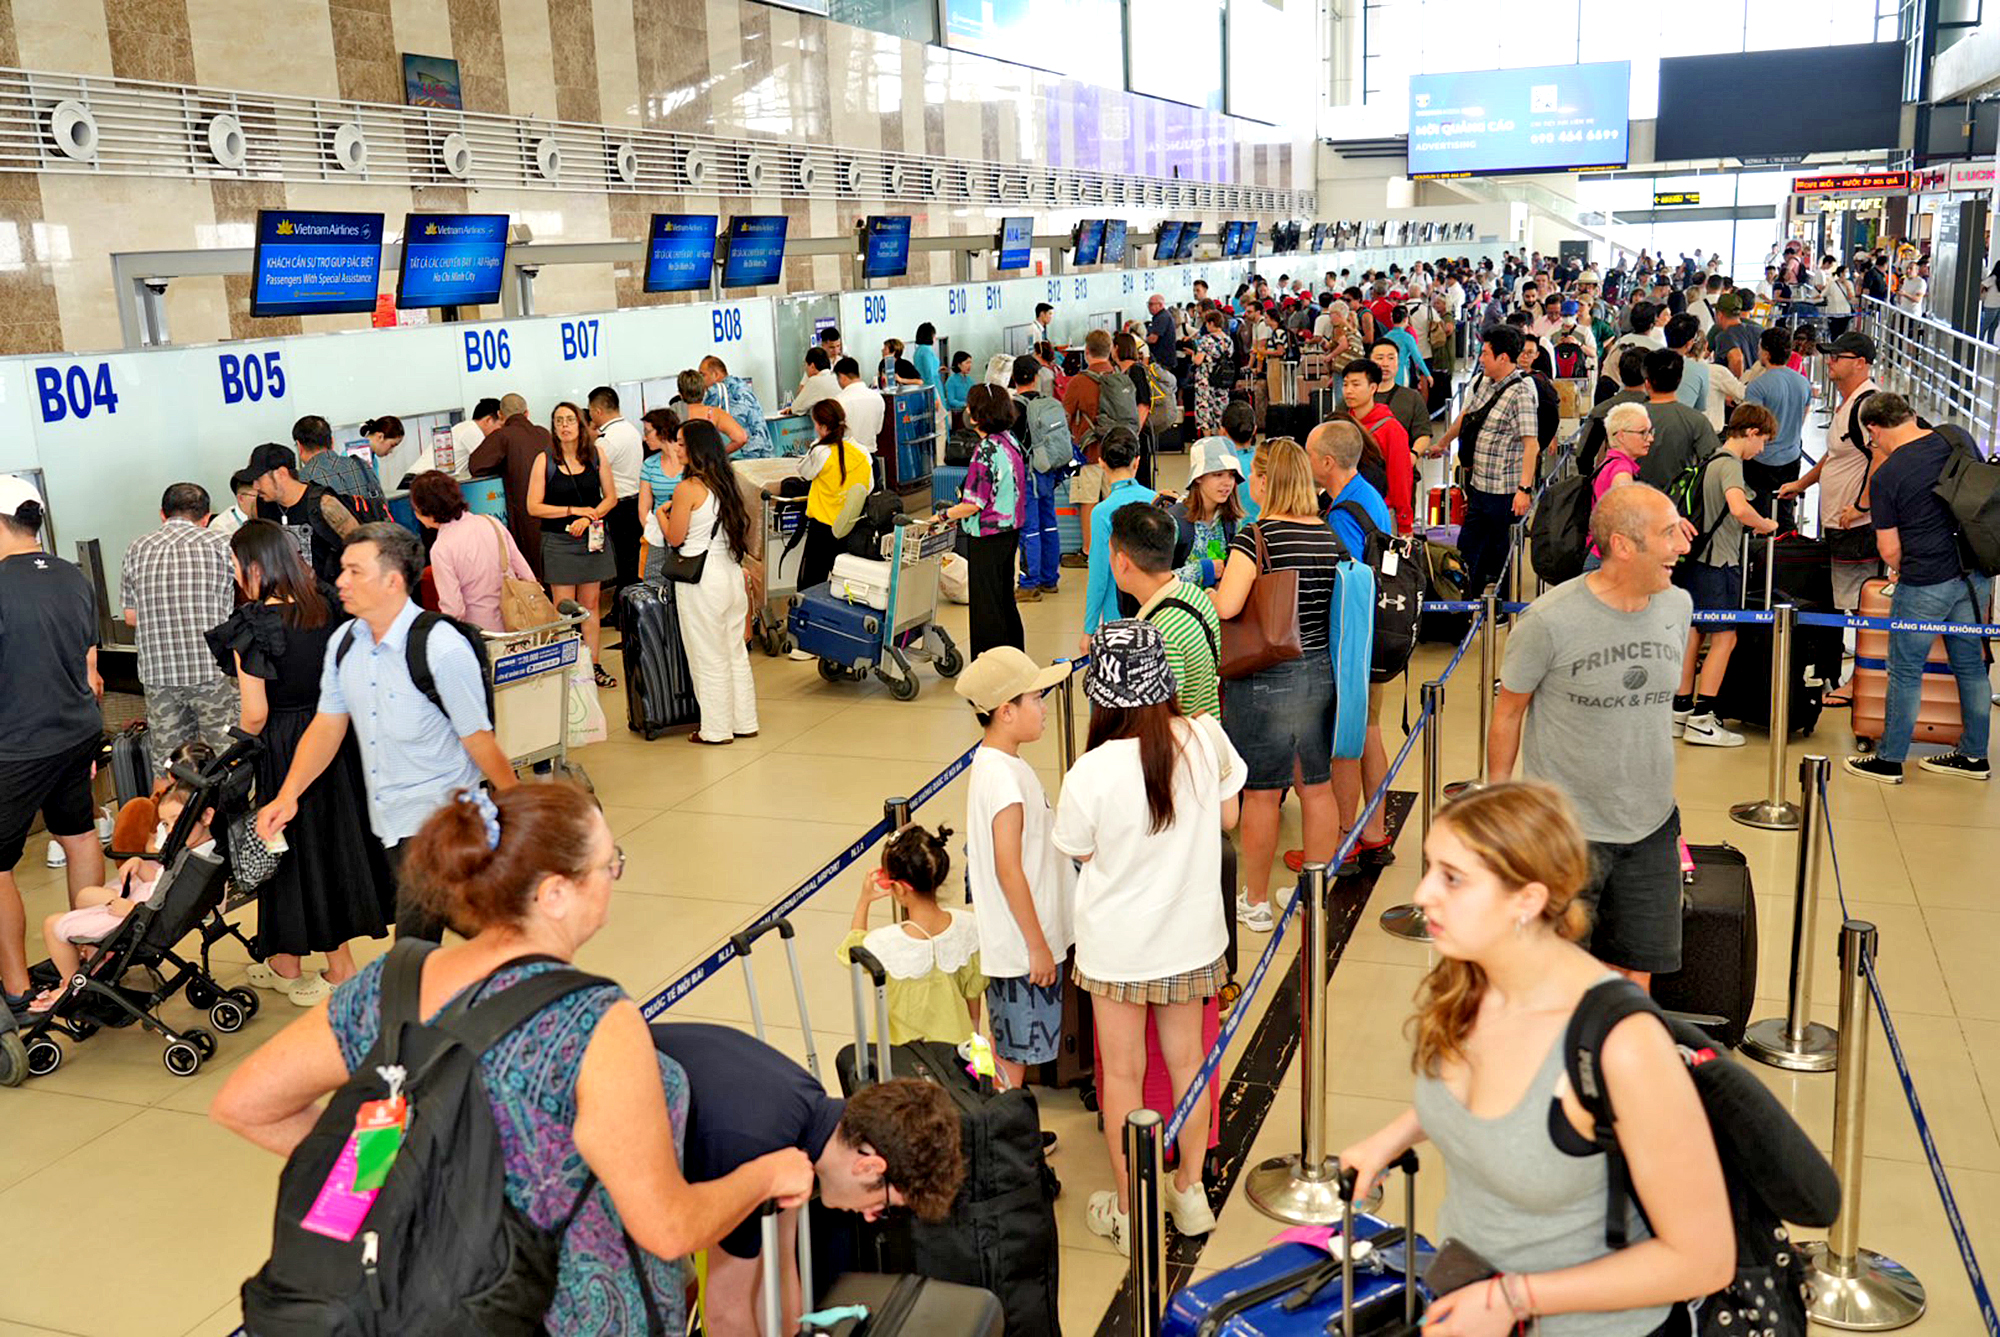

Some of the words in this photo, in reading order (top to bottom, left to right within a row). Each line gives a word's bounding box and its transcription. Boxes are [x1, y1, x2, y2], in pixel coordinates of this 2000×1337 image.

[1415, 140, 1477, 151] ADVERTISING
[1558, 129, 1583, 142] 464
[1850, 198, 1882, 211] CAFE
[265, 274, 302, 288] Passengers
[303, 273, 318, 284] With
[318, 273, 342, 287] Special
[342, 272, 372, 284] Assistance
[1048, 280, 1061, 302] B12
[1075, 278, 1087, 300] B13
[864, 295, 886, 324] B09
[949, 289, 966, 315] B10
[986, 286, 1001, 310] B11
[712, 308, 742, 343] B08
[464, 328, 511, 373] B06
[561, 319, 599, 361] B07
[218, 351, 286, 404] B05
[36, 362, 119, 423] B04
[1847, 618, 1869, 626] N.I.A
[1890, 620, 1918, 631] CẢNG
[1919, 622, 1947, 632] HÀNG
[1948, 623, 1983, 635] KHÔNG
[1571, 641, 1681, 677] PRINCETON
[1566, 691, 1626, 709] TRACK
[1628, 694, 1640, 706] &
[771, 879, 818, 920] INTERNATIONAL
[816, 860, 841, 884] AIRPORT
[643, 995, 666, 1019] QUỐC
[666, 986, 677, 1003] TẾ
[676, 976, 692, 995] NỘI
